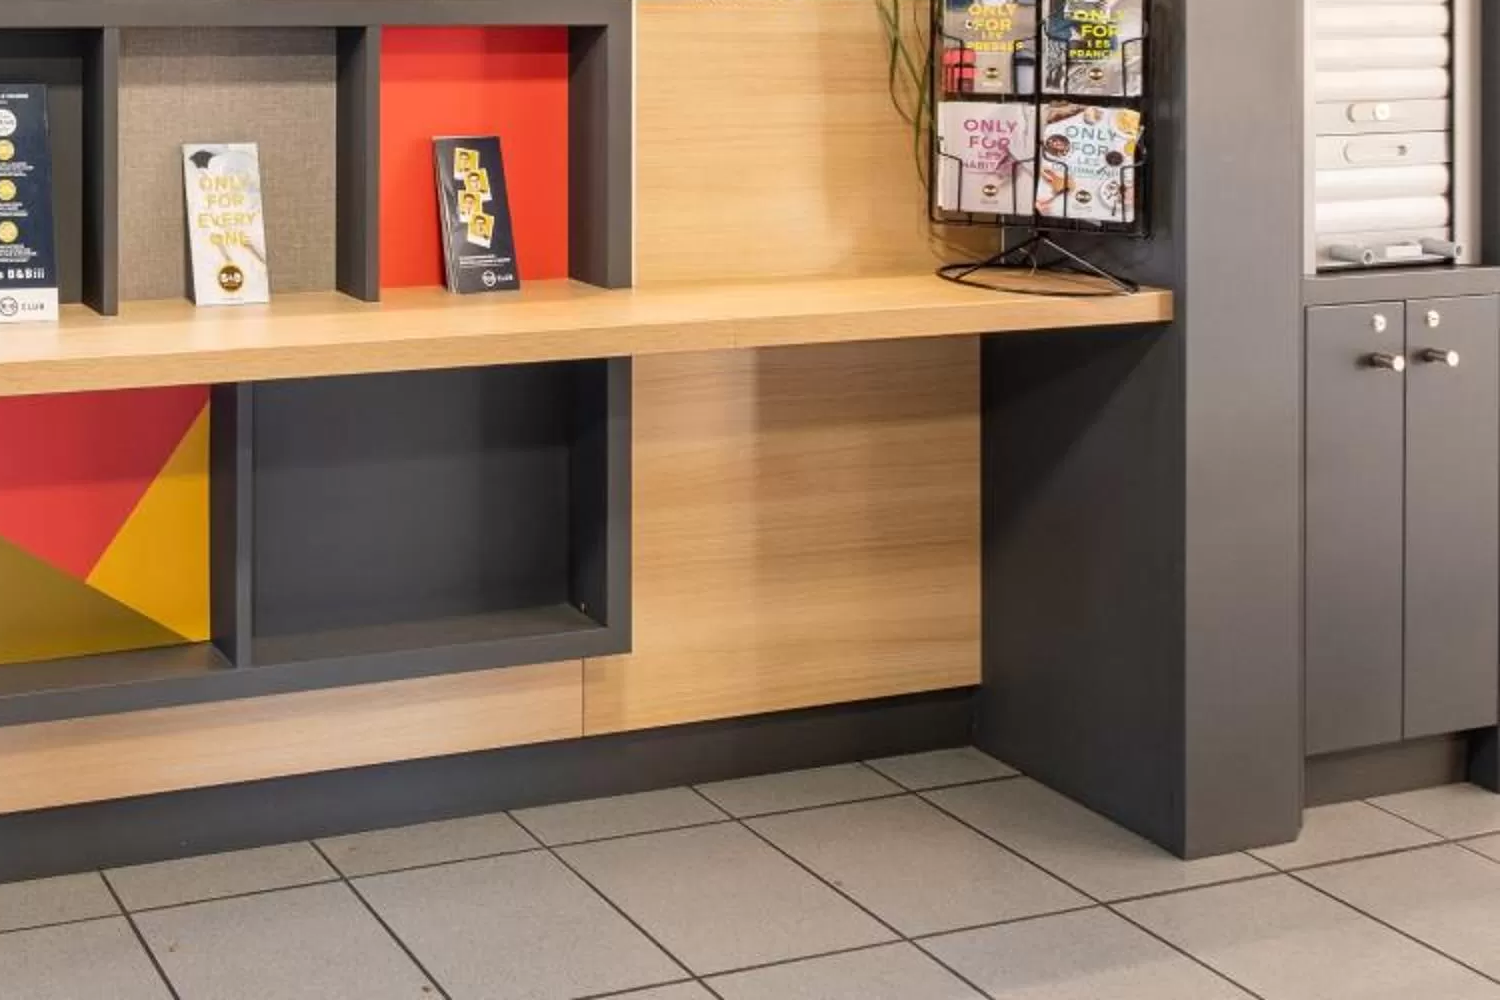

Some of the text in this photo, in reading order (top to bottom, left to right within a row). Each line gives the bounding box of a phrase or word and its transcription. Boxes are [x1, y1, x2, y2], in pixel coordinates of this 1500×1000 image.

[963, 119, 1018, 134] ONLY
[1065, 124, 1117, 142] ONLY
[206, 193, 245, 210] FOR
[197, 211, 256, 229] EVERY
